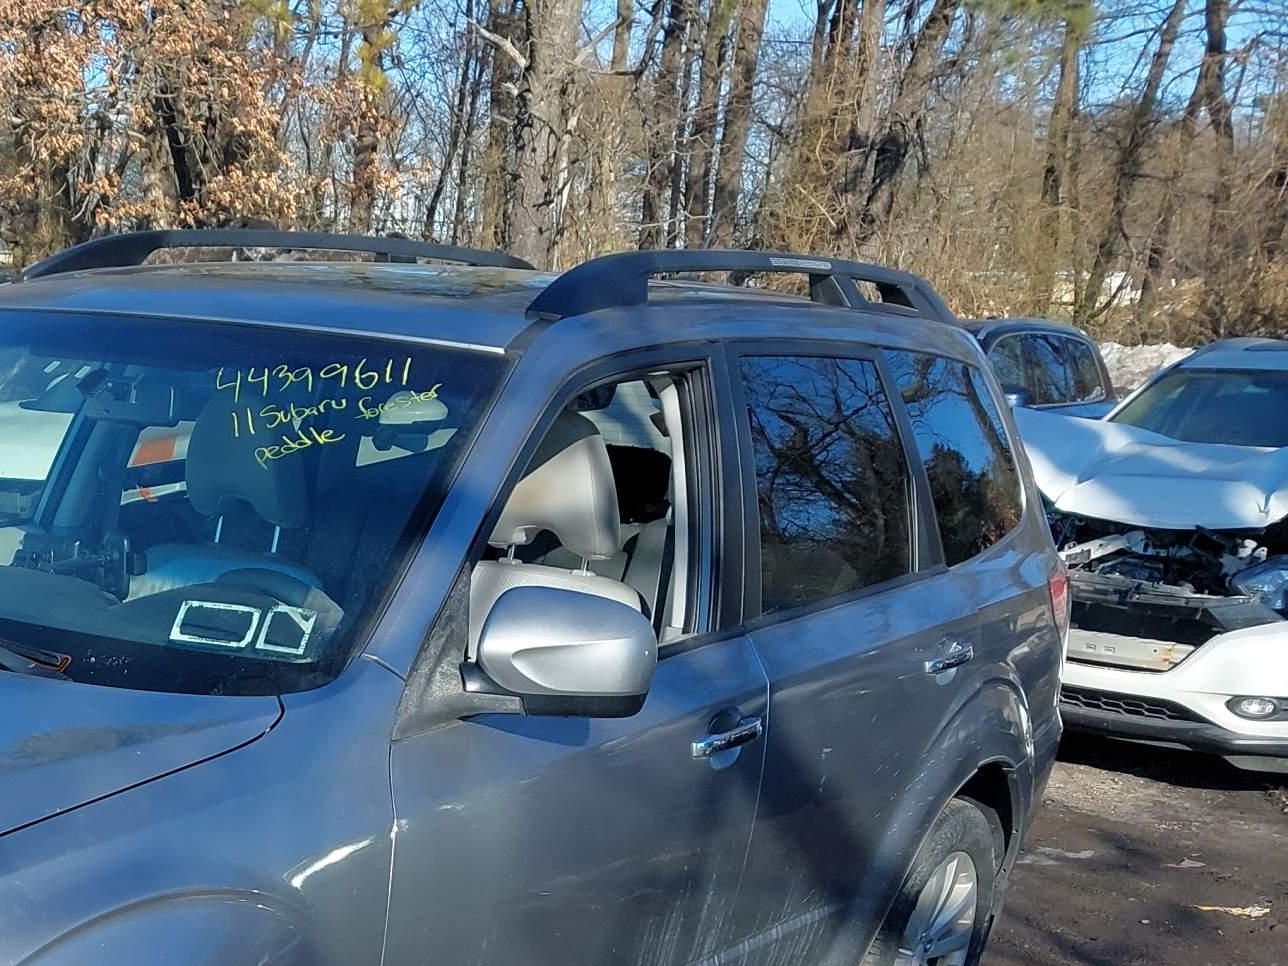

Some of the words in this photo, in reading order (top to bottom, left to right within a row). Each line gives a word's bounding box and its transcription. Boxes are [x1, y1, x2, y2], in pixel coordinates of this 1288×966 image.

[216, 357, 412, 404] 44399611
[231, 407, 256, 438] 11
[259, 398, 348, 429] Subaru
